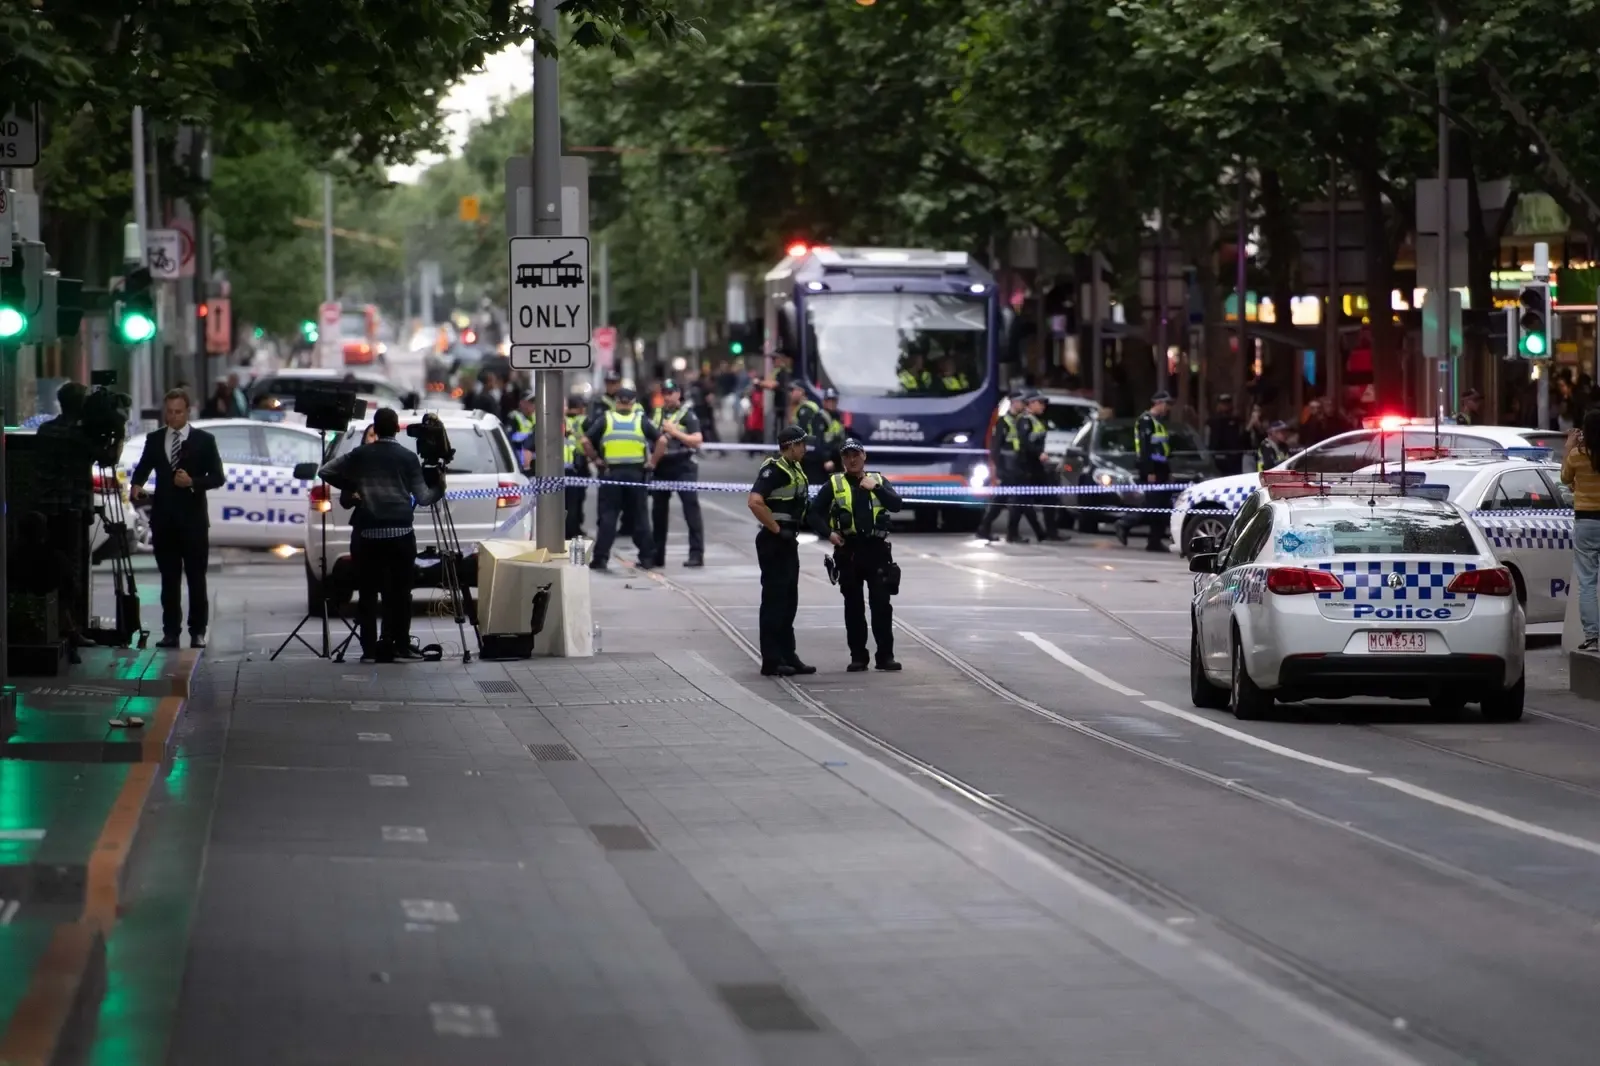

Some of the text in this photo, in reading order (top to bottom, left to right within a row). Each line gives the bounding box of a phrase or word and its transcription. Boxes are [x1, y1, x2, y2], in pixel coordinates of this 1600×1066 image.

[520, 304, 580, 328] ONLY
[529, 349, 572, 364] END
[222, 506, 306, 524] Polic
[1551, 578, 1570, 598] P
[1353, 603, 1452, 619] Police
[1370, 634, 1424, 647] MCW 543
